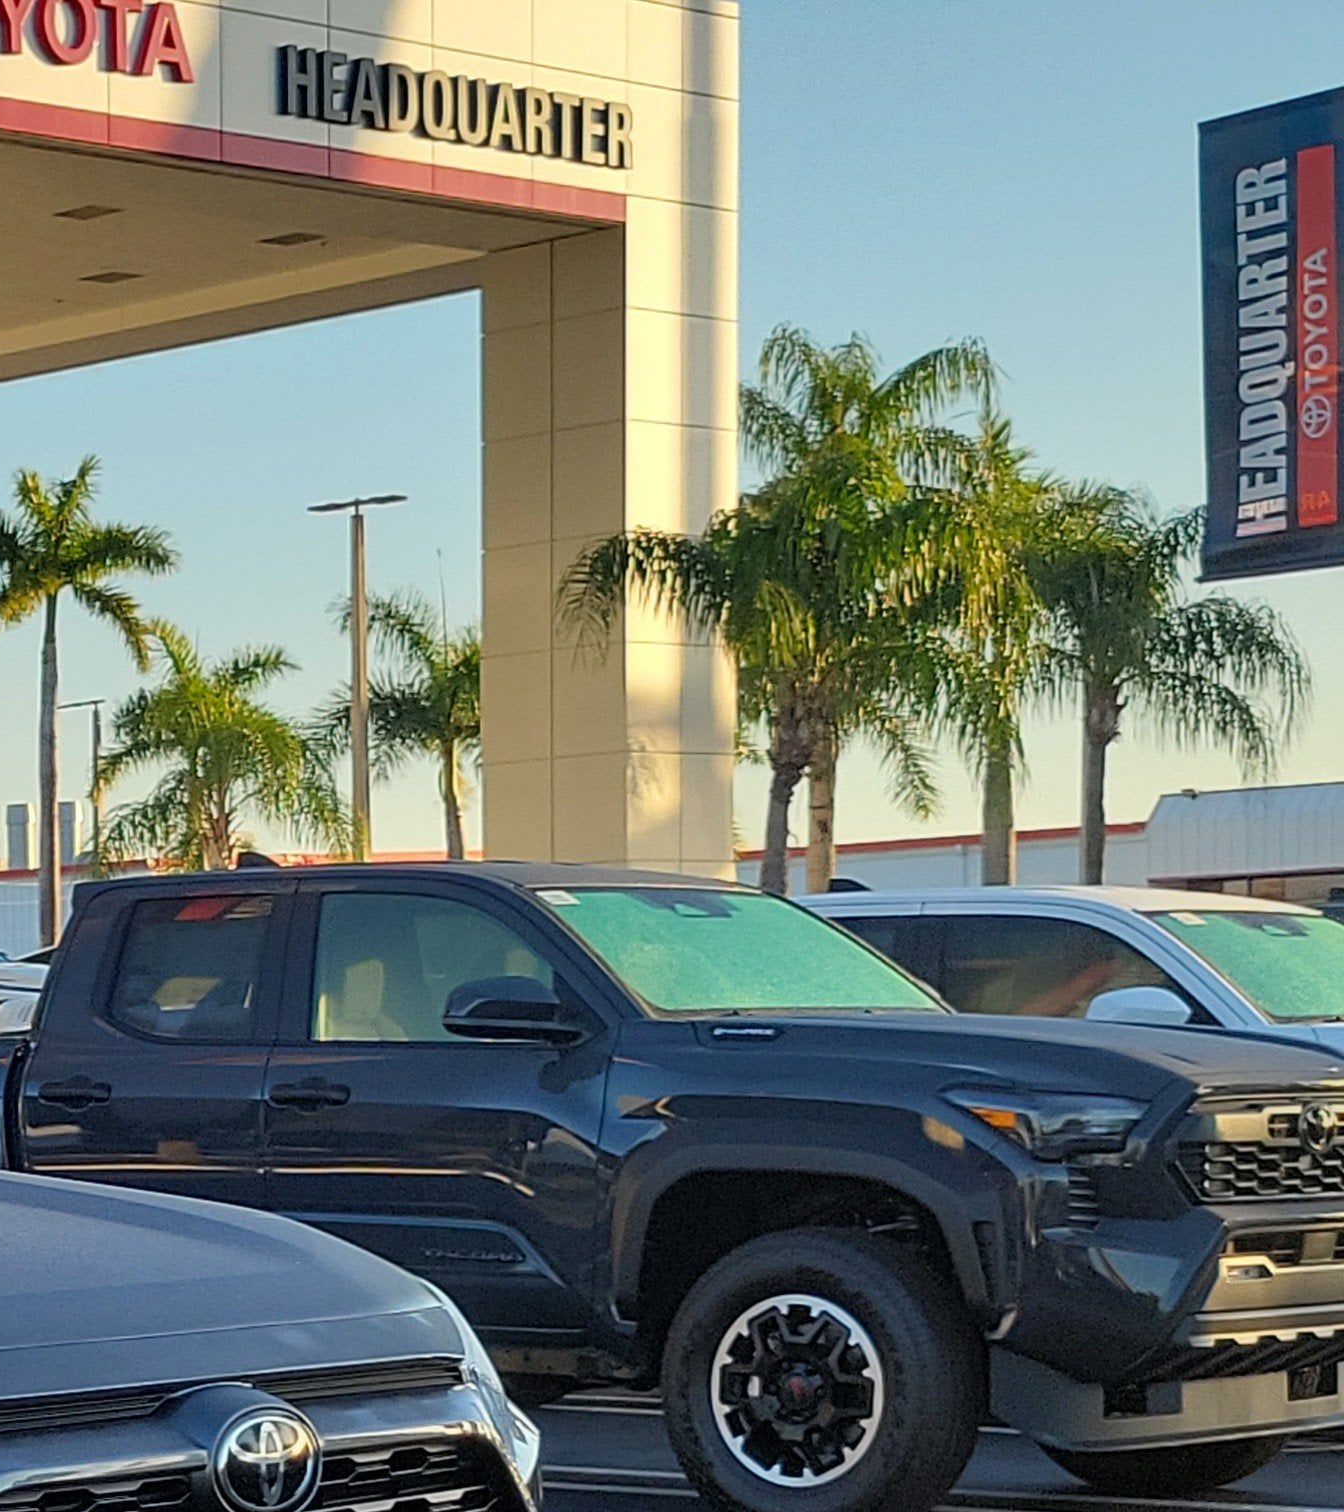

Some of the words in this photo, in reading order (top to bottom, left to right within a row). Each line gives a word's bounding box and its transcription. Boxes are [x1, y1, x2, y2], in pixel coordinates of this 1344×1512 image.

[276, 44, 633, 169] HEADQUARTER
[1235, 156, 1295, 538] HEADQUARTER
[1304, 246, 1330, 391] TOYOTA
